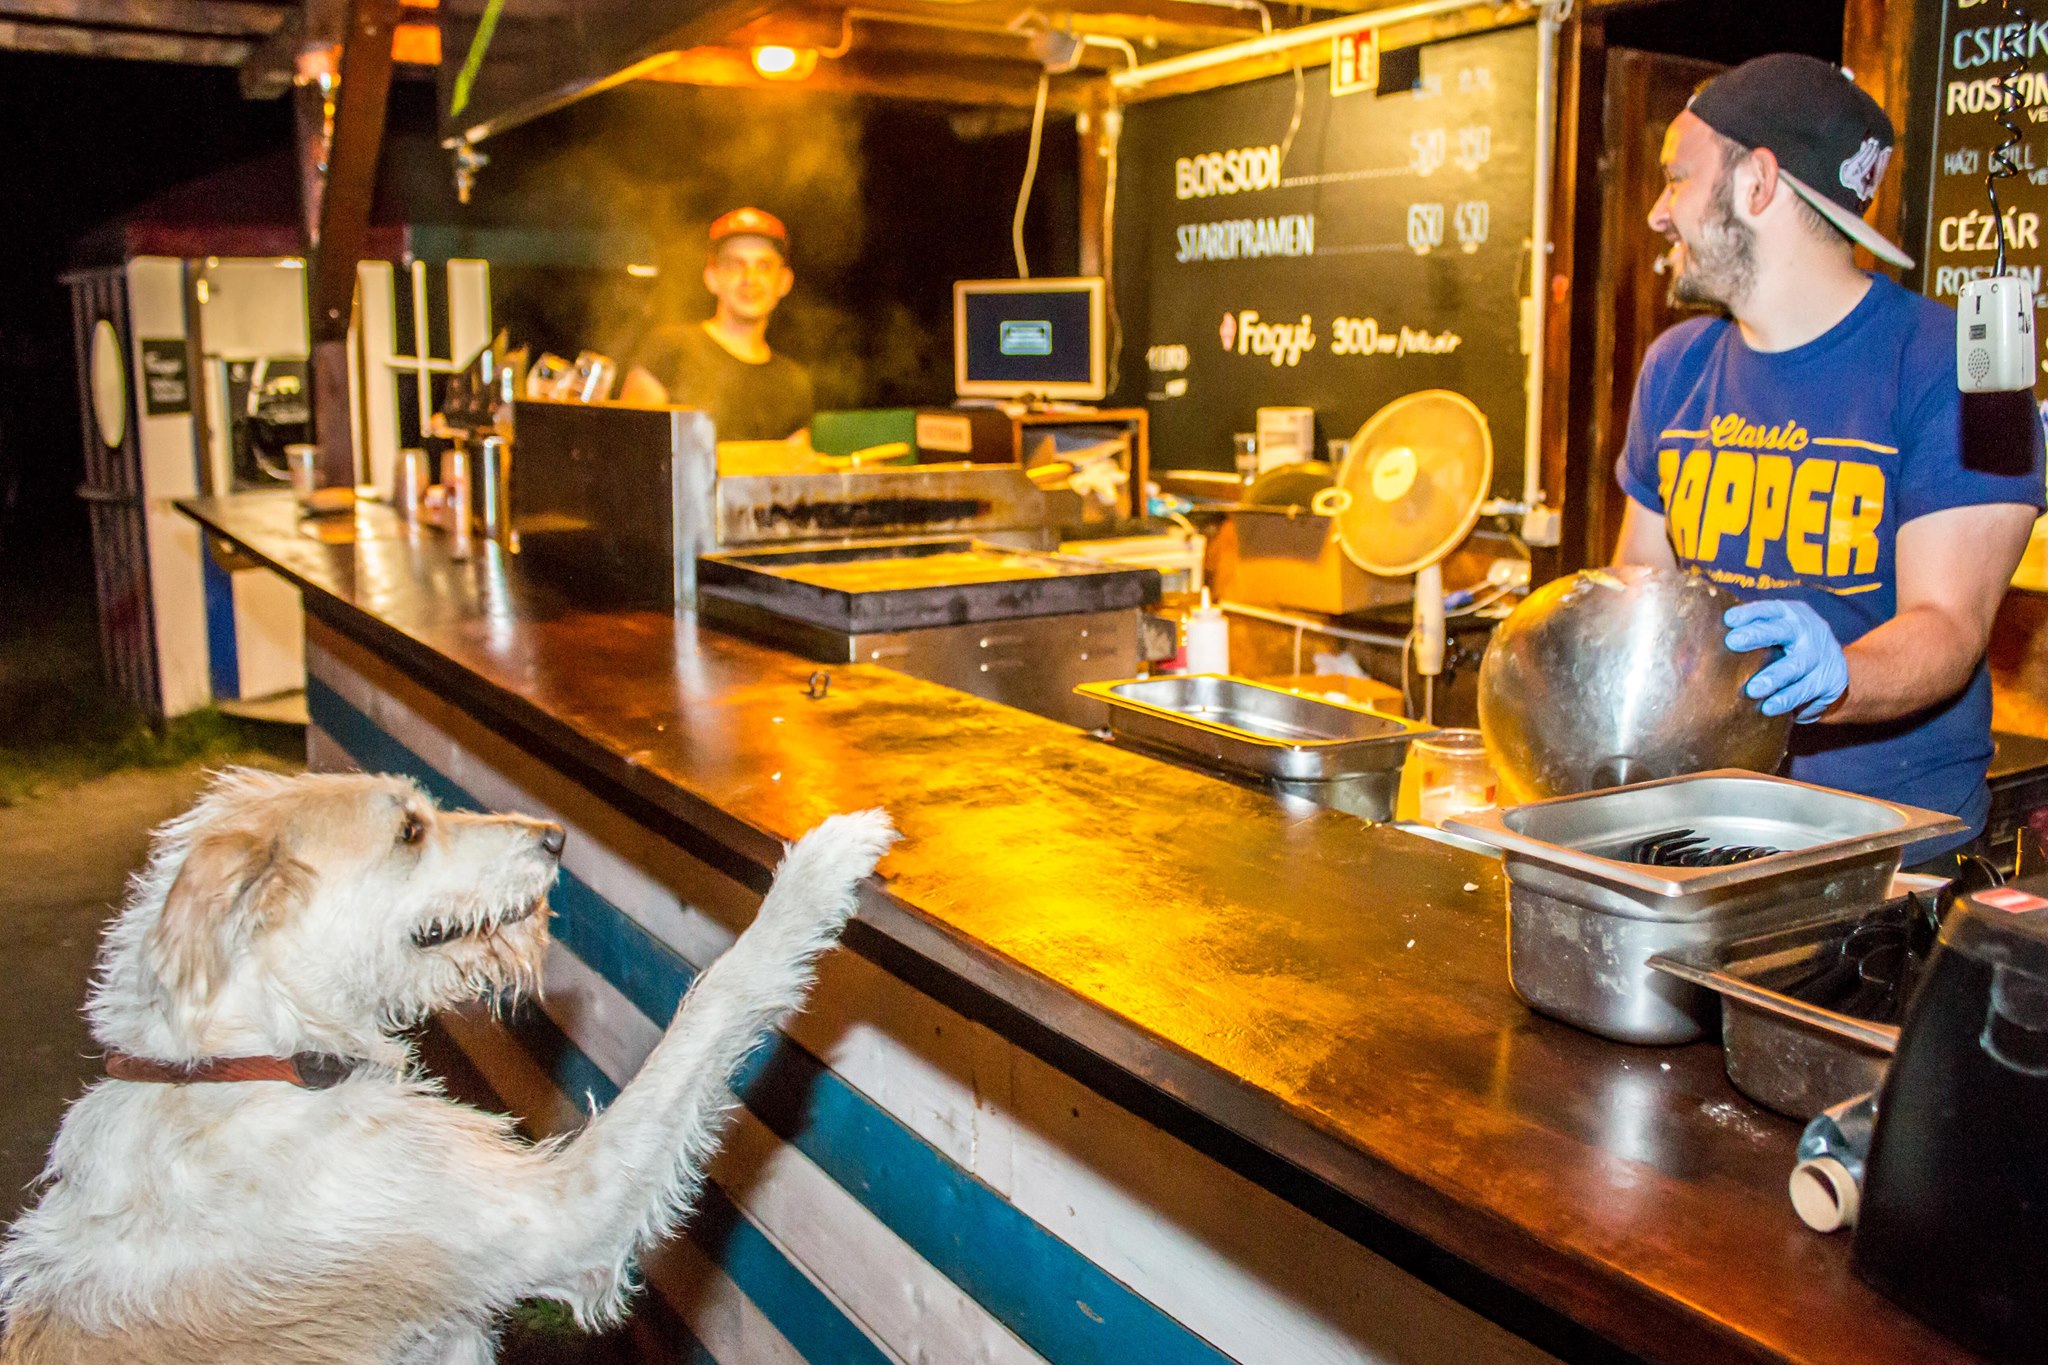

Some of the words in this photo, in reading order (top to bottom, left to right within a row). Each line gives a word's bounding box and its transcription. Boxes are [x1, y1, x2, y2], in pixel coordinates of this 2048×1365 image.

[1176, 144, 1280, 200] BORSODI
[1939, 205, 2040, 252] CÉZÁR
[1710, 412, 1810, 452] Classic
